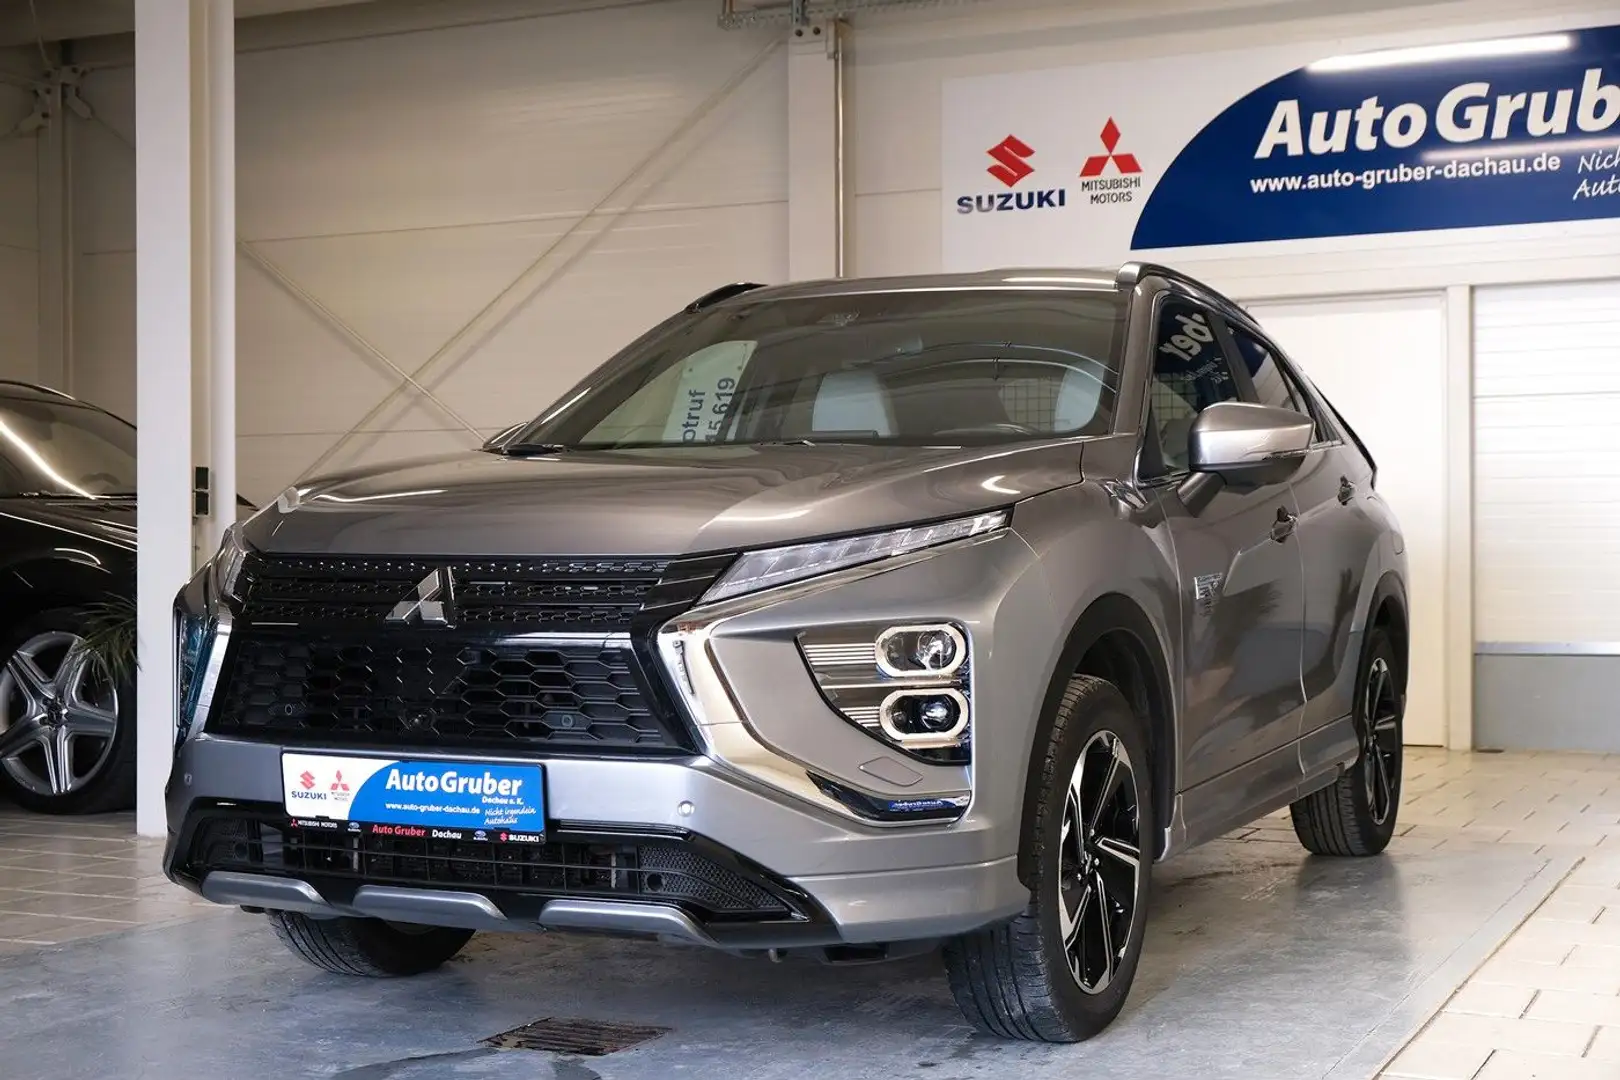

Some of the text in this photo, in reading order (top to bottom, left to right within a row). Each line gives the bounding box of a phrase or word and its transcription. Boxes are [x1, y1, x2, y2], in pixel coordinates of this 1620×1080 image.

[1250, 152, 1560, 194] www.auto-gruber-dachau.de
[1081, 176, 1142, 192] MITSUBISHI
[1572, 174, 1620, 201] Aut
[957, 189, 1065, 215] SUZUKI
[1090, 191, 1133, 205] MOTORS
[291, 790, 327, 800] SUZUKI
[385, 802, 480, 814] www.auto-gruber-dachau.de
[372, 824, 393, 835] Auto
[394, 825, 426, 837] Gruber
[432, 829, 462, 840] Dachau
[508, 833, 540, 843] SUZUKI
